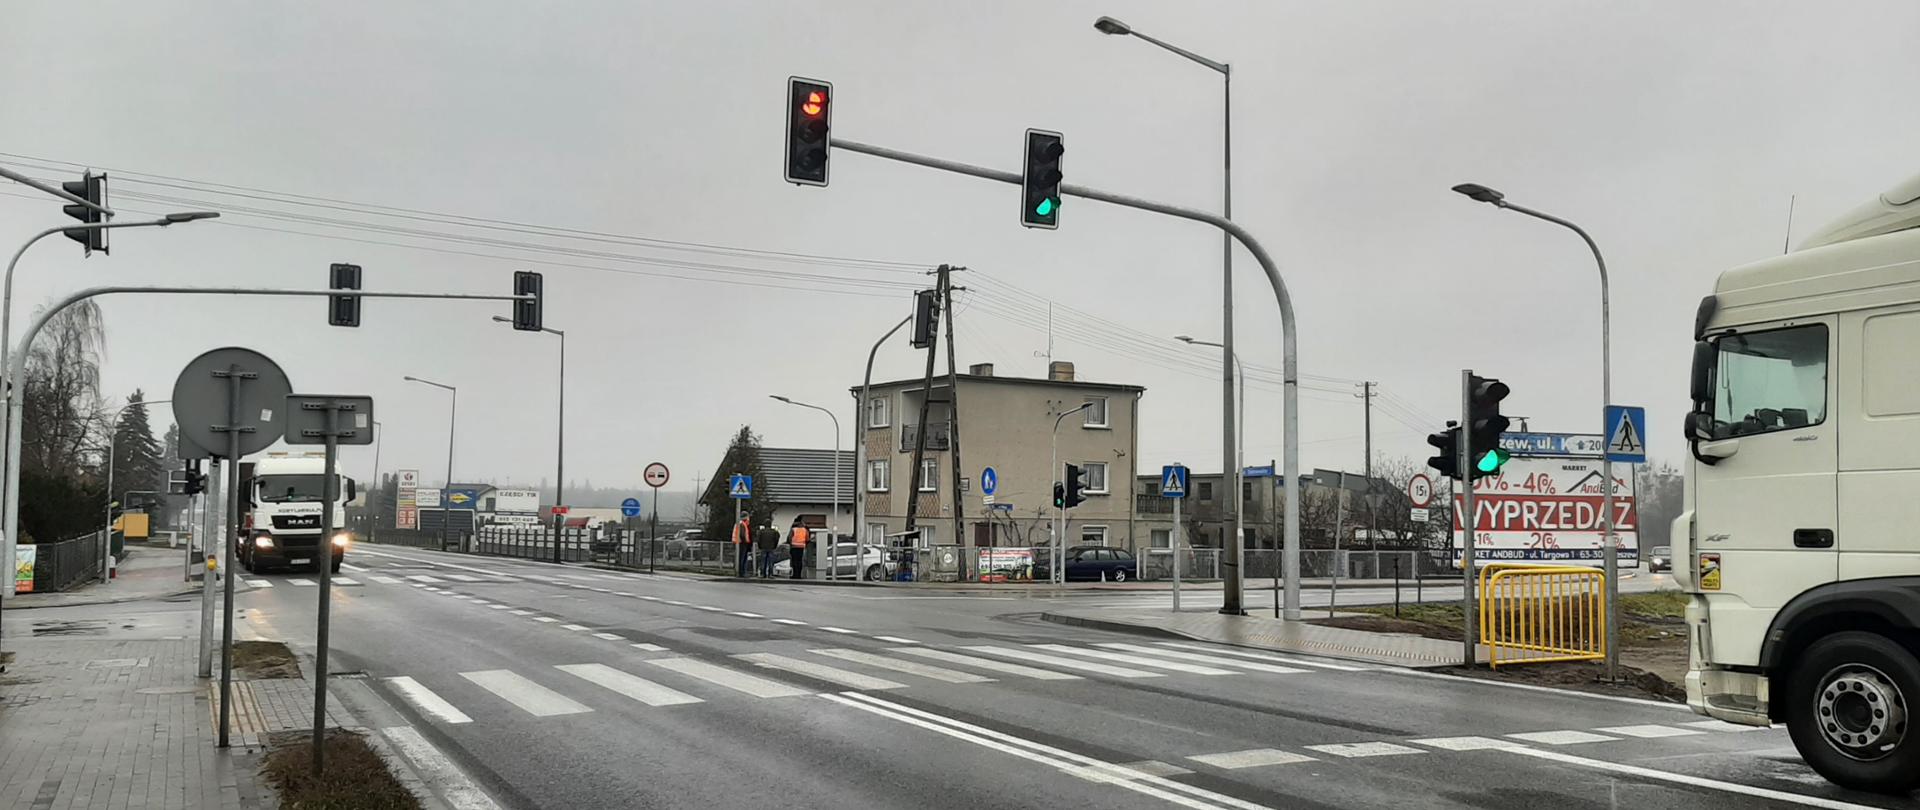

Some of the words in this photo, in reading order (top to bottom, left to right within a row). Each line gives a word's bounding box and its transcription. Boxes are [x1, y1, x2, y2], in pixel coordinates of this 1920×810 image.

[1536, 437, 1555, 450] ul.
[1589, 440, 1605, 451] 20
[1580, 483, 1619, 494] AndBd
[1457, 550, 1490, 559] MKET
[1491, 550, 1525, 559] ANDBUD
[1540, 551, 1570, 561] Targowa
[1579, 551, 1605, 559] 63-30
